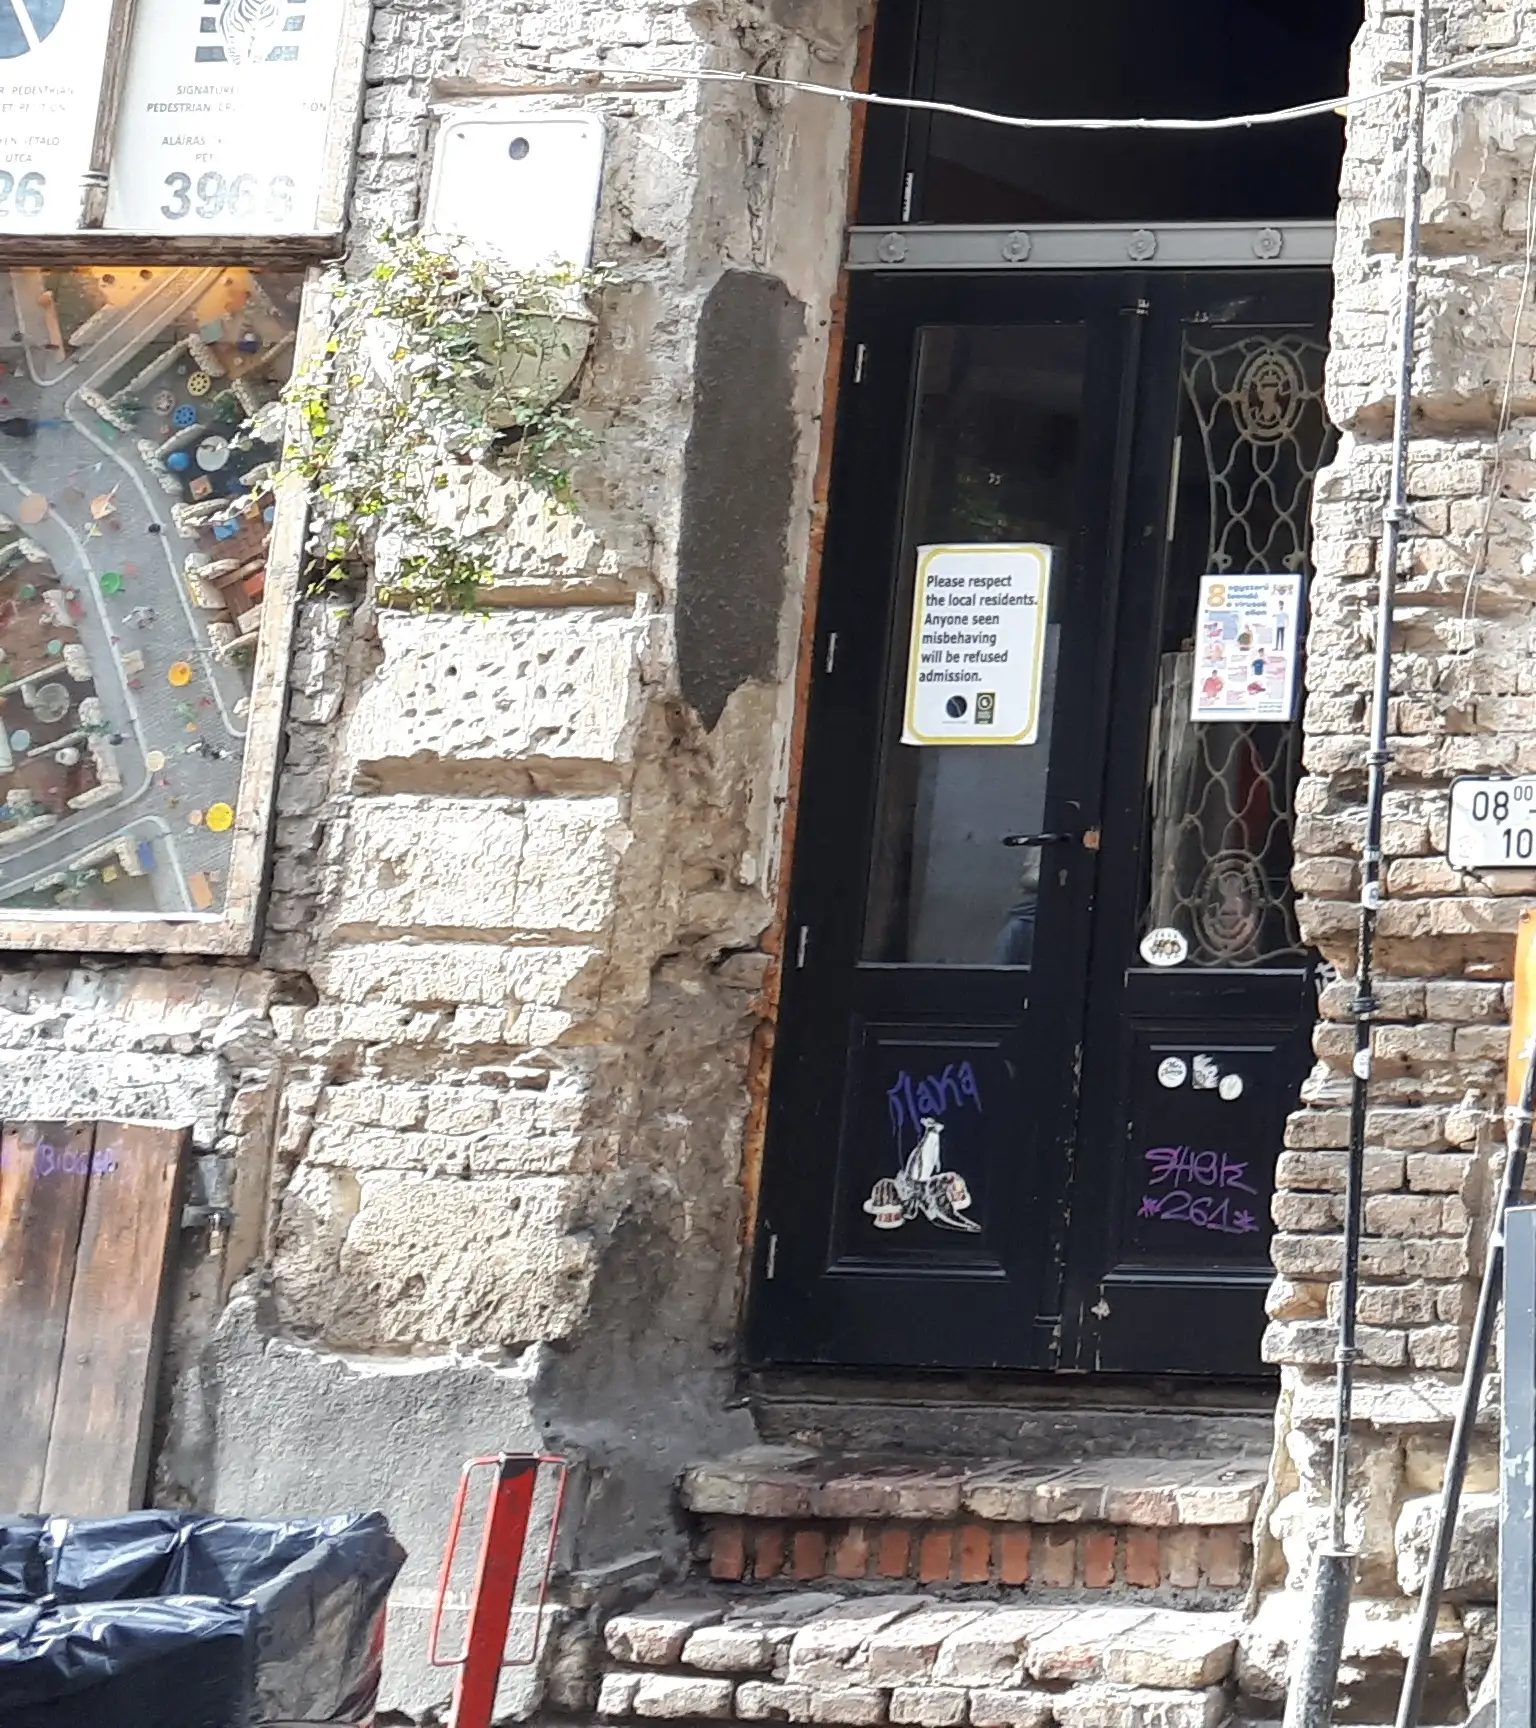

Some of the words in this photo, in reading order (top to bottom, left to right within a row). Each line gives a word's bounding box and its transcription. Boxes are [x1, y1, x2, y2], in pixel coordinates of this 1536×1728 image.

[146, 103, 212, 113] PEDESTRIAN
[926, 575, 965, 587] Please
[968, 574, 1012, 589] respect
[925, 594, 945, 606] the
[948, 593, 976, 606] local
[979, 593, 1038, 606] residents.
[1207, 583, 1226, 608] 8
[924, 613, 969, 628] Anyone
[972, 614, 999, 625] seen
[922, 631, 997, 647] misbehaving
[920, 650, 942, 663] will
[945, 650, 960, 663] be
[963, 650, 1008, 663] refused
[919, 670, 982, 682] admission.
[1502, 828, 1534, 859] 10
